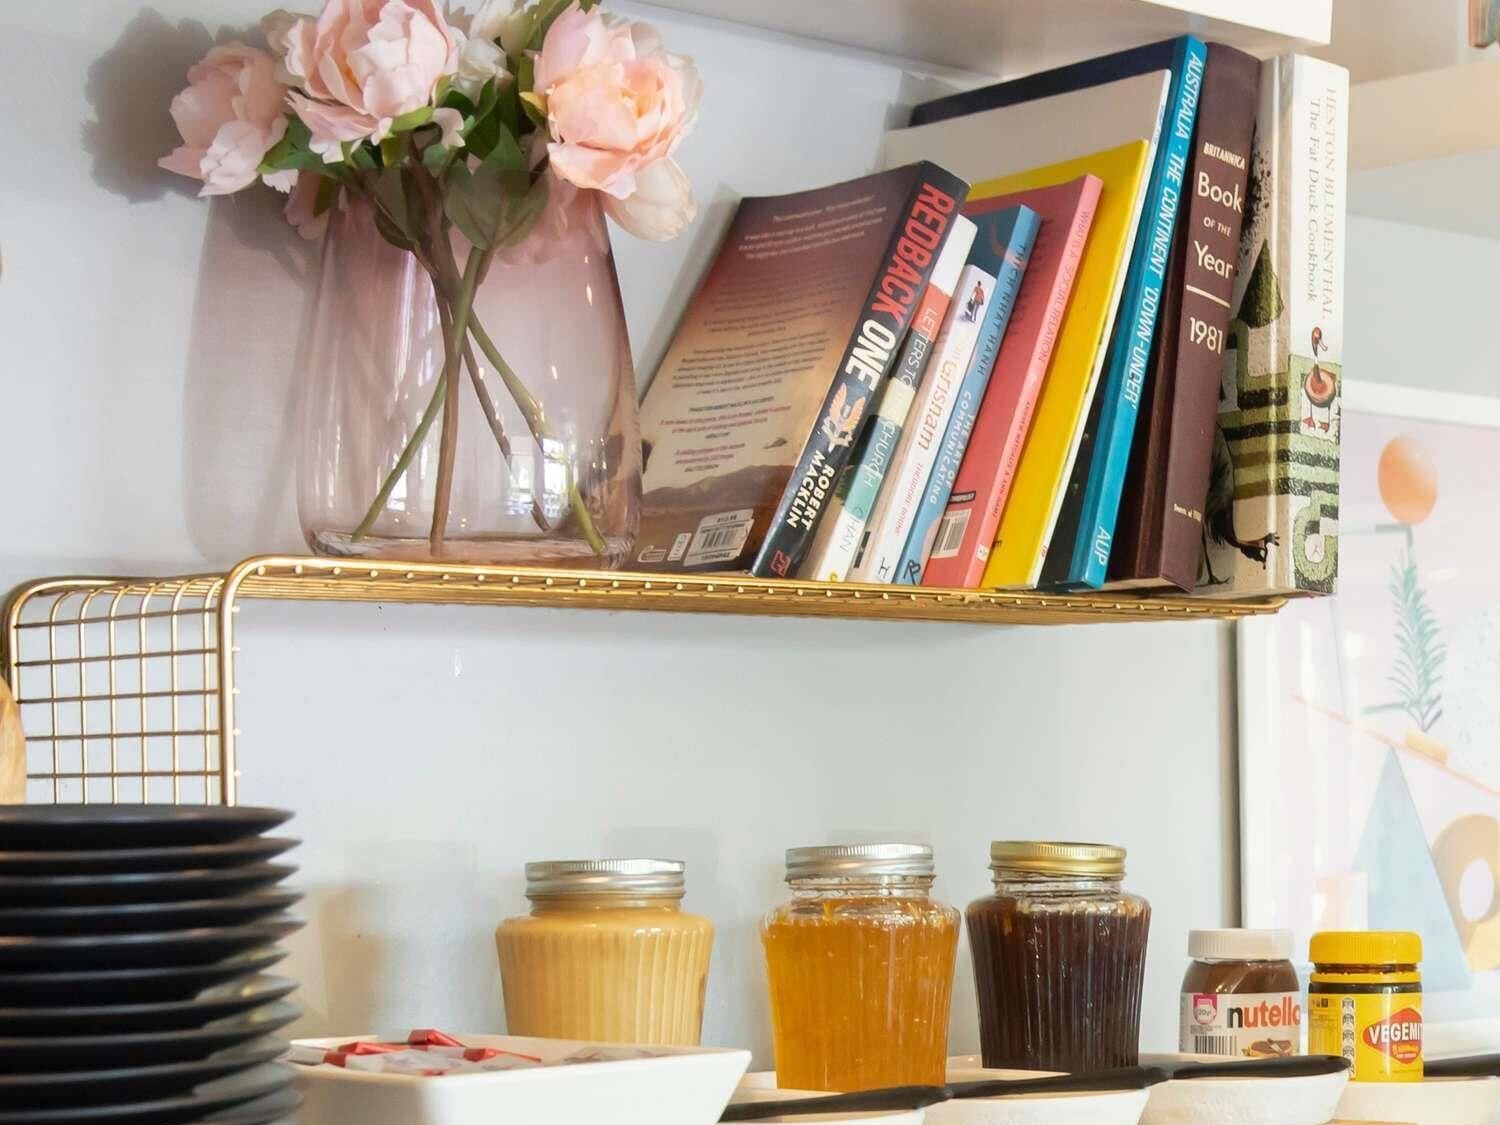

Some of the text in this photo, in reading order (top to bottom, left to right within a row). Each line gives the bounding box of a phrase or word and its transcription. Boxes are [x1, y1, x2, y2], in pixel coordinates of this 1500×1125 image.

[1175, 52, 1202, 139] AUSTRALIA
[1167, 152, 1186, 187] THE
[1203, 142, 1246, 170] BRITANNICA
[1197, 171, 1243, 214] Book
[1306, 99, 1321, 303] The Fat Duck Cookbook
[1320, 88, 1337, 319] HESTON BLUMENTHAL
[1150, 187, 1179, 279] CONTINENT
[1203, 215, 1233, 237] OF THE
[845, 182, 956, 392] REDBACK ONE
[1194, 240, 1234, 280] Year
[908, 307, 938, 370] LETTERS
[976, 334, 995, 375] HANH
[1189, 316, 1223, 356] 1981
[863, 420, 897, 489] CHURCH
[930, 390, 972, 505] COMMUNICATING
[961, 413, 974, 438] THE
[786, 450, 826, 530] MACKLIN
[799, 463, 836, 531] ROBERT
[1094, 526, 1111, 567] AUP
